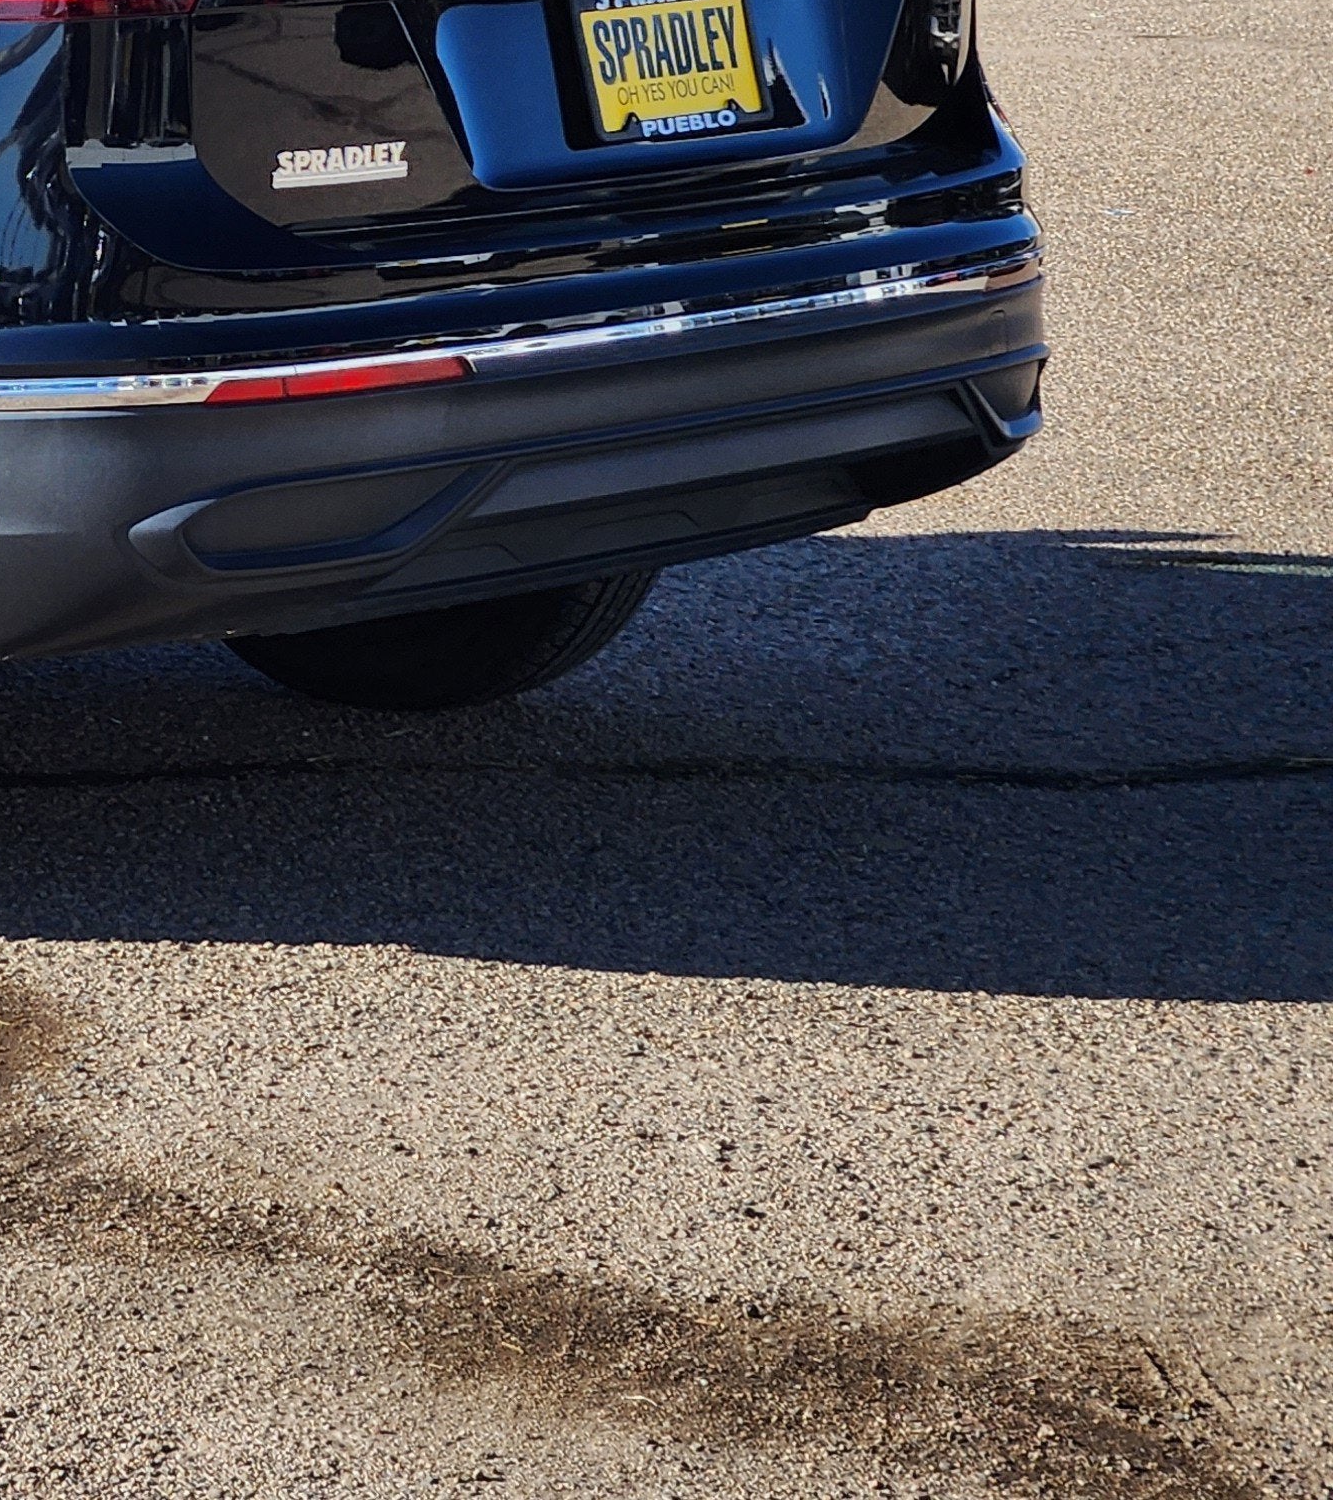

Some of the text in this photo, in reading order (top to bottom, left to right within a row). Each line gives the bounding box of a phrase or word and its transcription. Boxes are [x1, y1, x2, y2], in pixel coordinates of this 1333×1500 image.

[593, 5, 738, 85] SPRADLEY
[617, 73, 736, 106] OH YES YOU CAN!
[641, 109, 737, 138] PUEBLO
[275, 141, 406, 176] SPRADLEY
